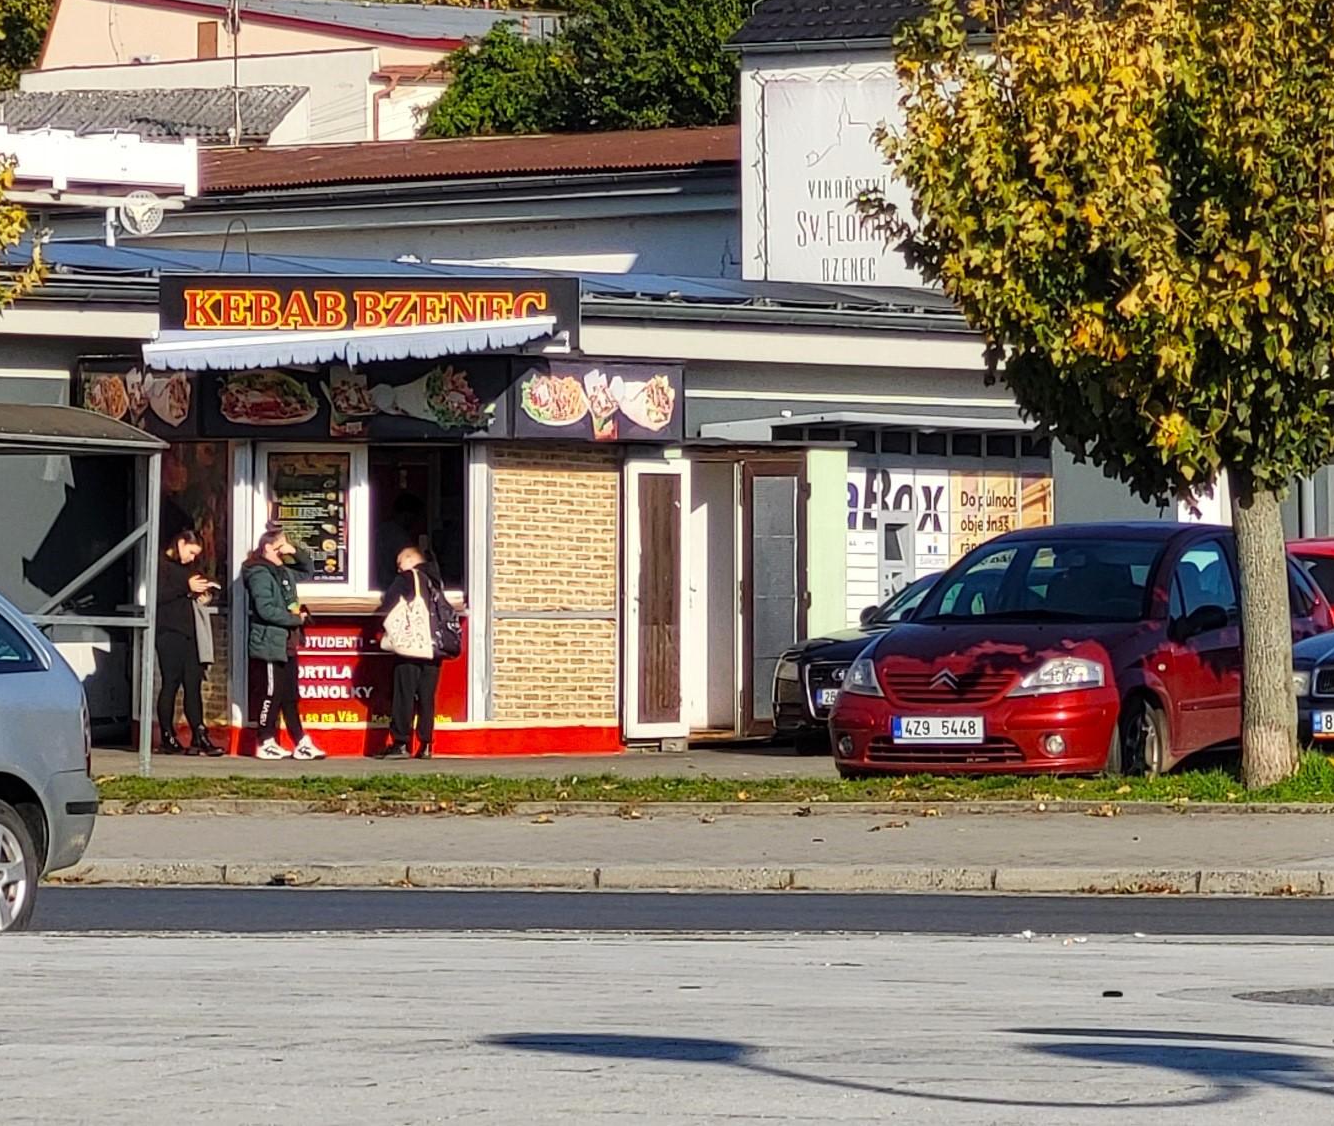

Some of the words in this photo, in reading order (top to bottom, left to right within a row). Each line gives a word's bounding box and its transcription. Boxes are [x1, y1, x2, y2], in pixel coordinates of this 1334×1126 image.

[822, 257, 876, 282] BZENEC
[184, 289, 346, 330] KEBAB
[353, 291, 547, 331] BZENEC
[960, 490, 976, 507] Do
[298, 685, 373, 699] RANOLKY
[905, 720, 930, 736] 4Z9
[941, 720, 976, 736] 5448
